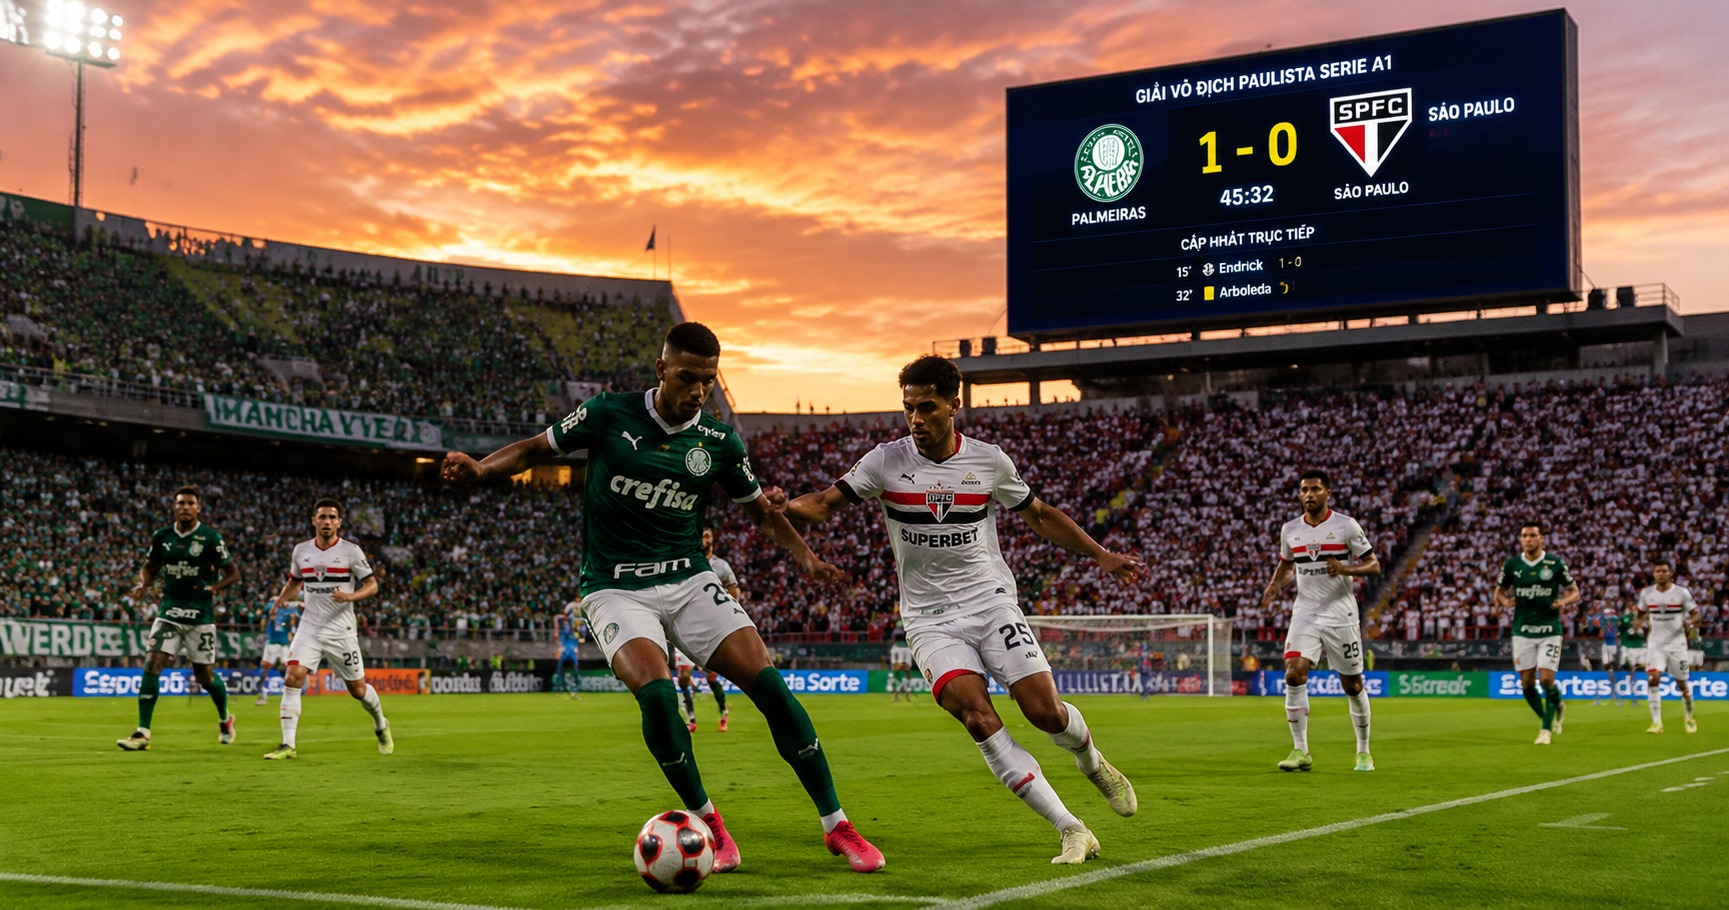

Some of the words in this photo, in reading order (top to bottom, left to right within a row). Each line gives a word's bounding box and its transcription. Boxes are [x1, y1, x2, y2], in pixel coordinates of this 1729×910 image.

[1195, 76, 1235, 98] ĐỊCH
[1239, 66, 1316, 90] PAULISTA
[1319, 58, 1367, 79] SERIE
[1371, 54, 1392, 72] A1
[1338, 97, 1403, 121] SPFC
[1464, 97, 1515, 118] PAULO
[1199, 131, 1222, 174] 1
[1268, 121, 1298, 167] 0
[1219, 184, 1274, 206] 45:32
[1365, 181, 1409, 197] PAULO
[1071, 205, 1146, 226] PALMEIRAS
[1219, 259, 1263, 274] Endrick
[1219, 283, 1272, 298] Arboleda
[610, 474, 698, 511] crefisa
[901, 528, 979, 548] SUPERBET
[998, 622, 1034, 651] 25
[342, 650, 360, 667] 28
[806, 672, 860, 691] Sorte
